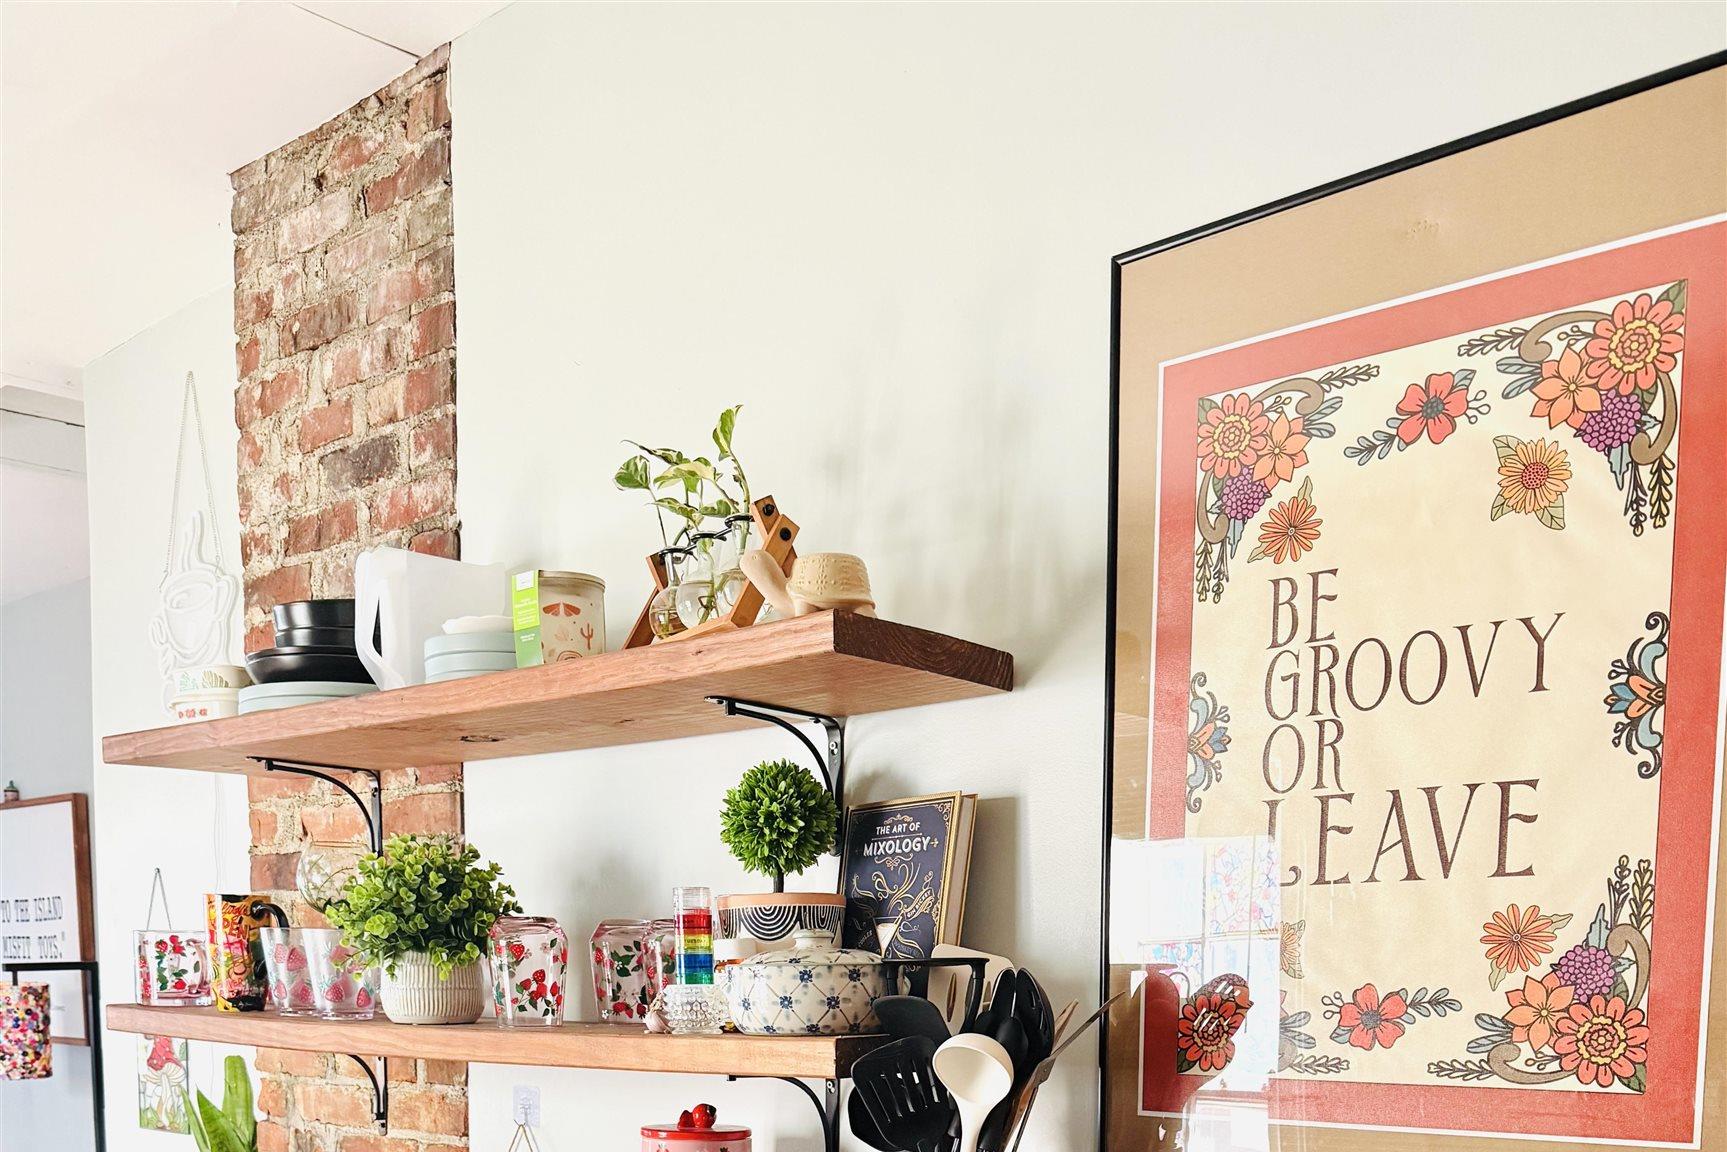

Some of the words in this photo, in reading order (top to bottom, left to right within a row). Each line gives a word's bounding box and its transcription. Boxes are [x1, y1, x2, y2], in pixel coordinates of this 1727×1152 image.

[1266, 567, 1339, 650] BE
[1264, 612, 1566, 721] GROOVY
[1262, 718, 1346, 795] OR
[863, 836, 931, 857] MIXOLOGY
[876, 825, 891, 835] THE
[891, 823, 908, 834] ART
[909, 821, 921, 832] OF
[1262, 778, 1540, 887] LEAVE
[34, 896, 64, 921] ISLAND
